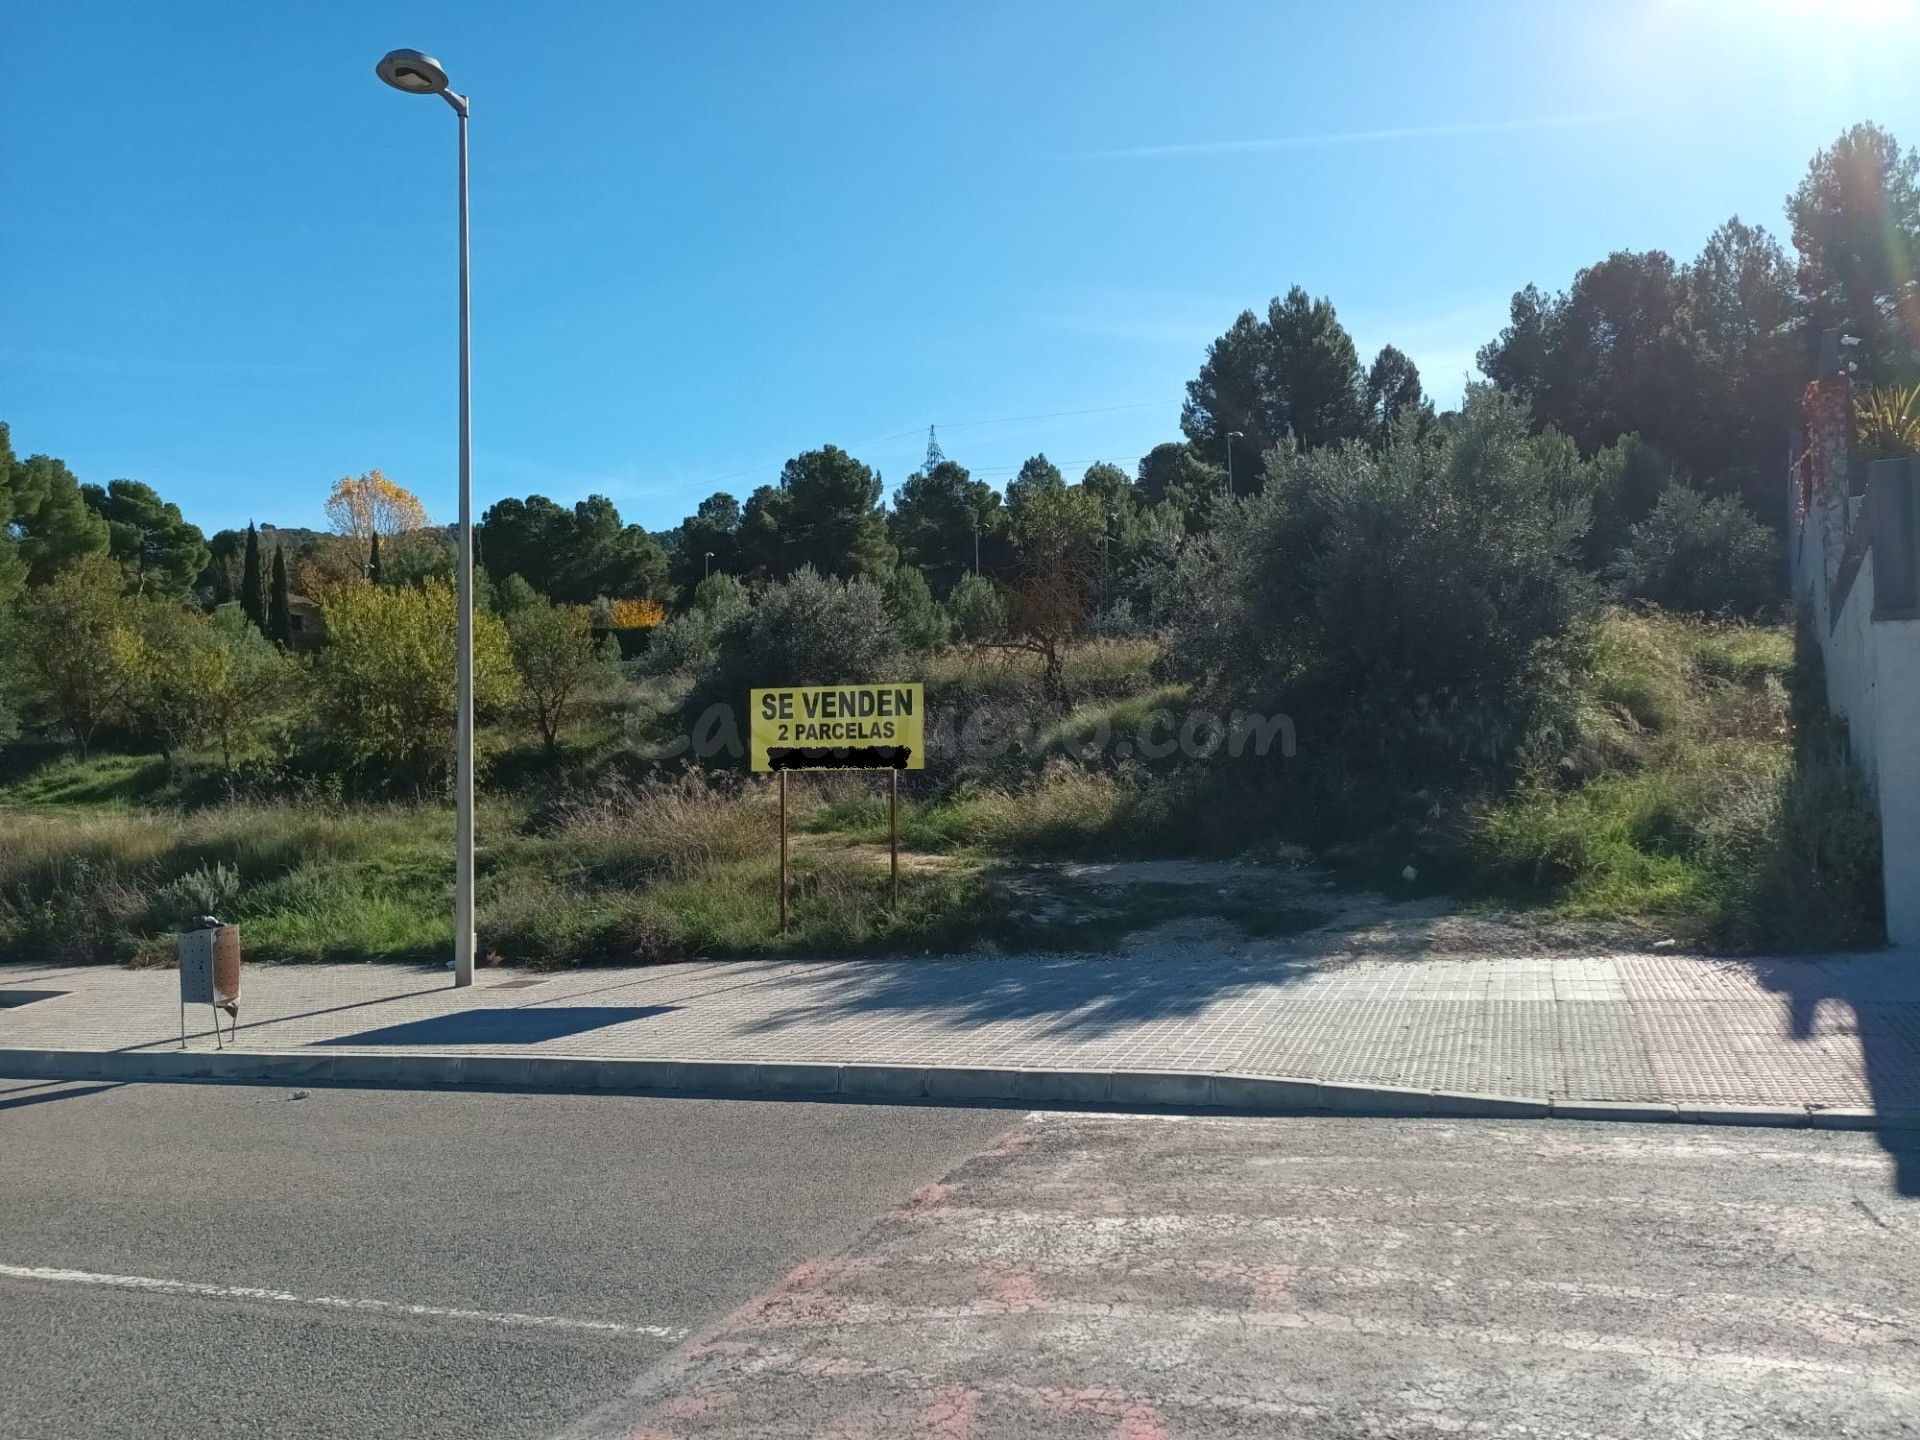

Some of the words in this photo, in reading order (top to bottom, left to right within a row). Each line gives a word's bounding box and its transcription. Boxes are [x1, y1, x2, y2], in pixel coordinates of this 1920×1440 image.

[762, 692, 794, 720] SE
[802, 689, 913, 719] VENDEN
[778, 724, 788, 741] 2
[795, 721, 896, 741] PARCELAS
